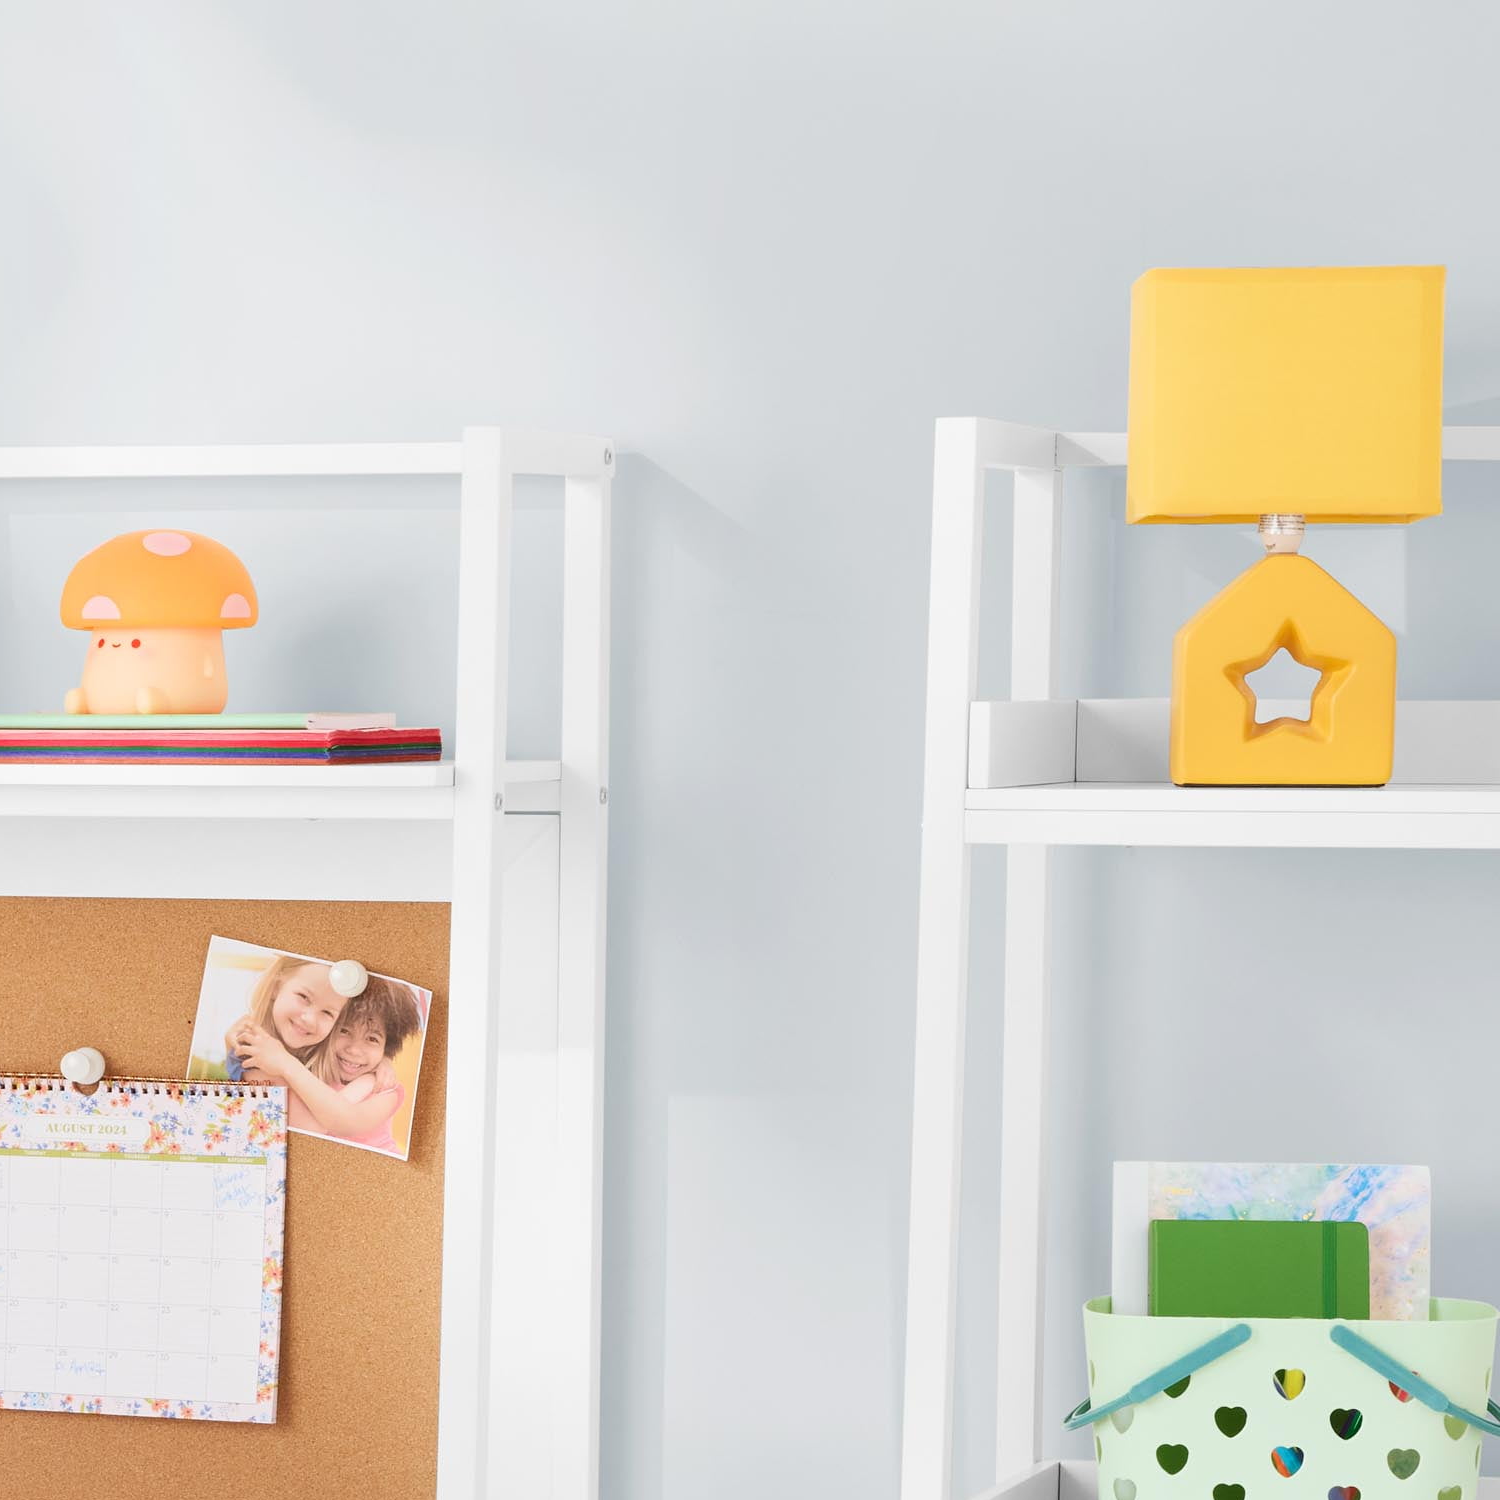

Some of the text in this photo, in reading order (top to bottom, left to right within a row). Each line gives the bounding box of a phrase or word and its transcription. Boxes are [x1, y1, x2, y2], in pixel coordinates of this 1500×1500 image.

[46, 1123, 127, 1136] AUGUST 2024
[110, 1304, 119, 1312] 22
[161, 1306, 171, 1314] 23
